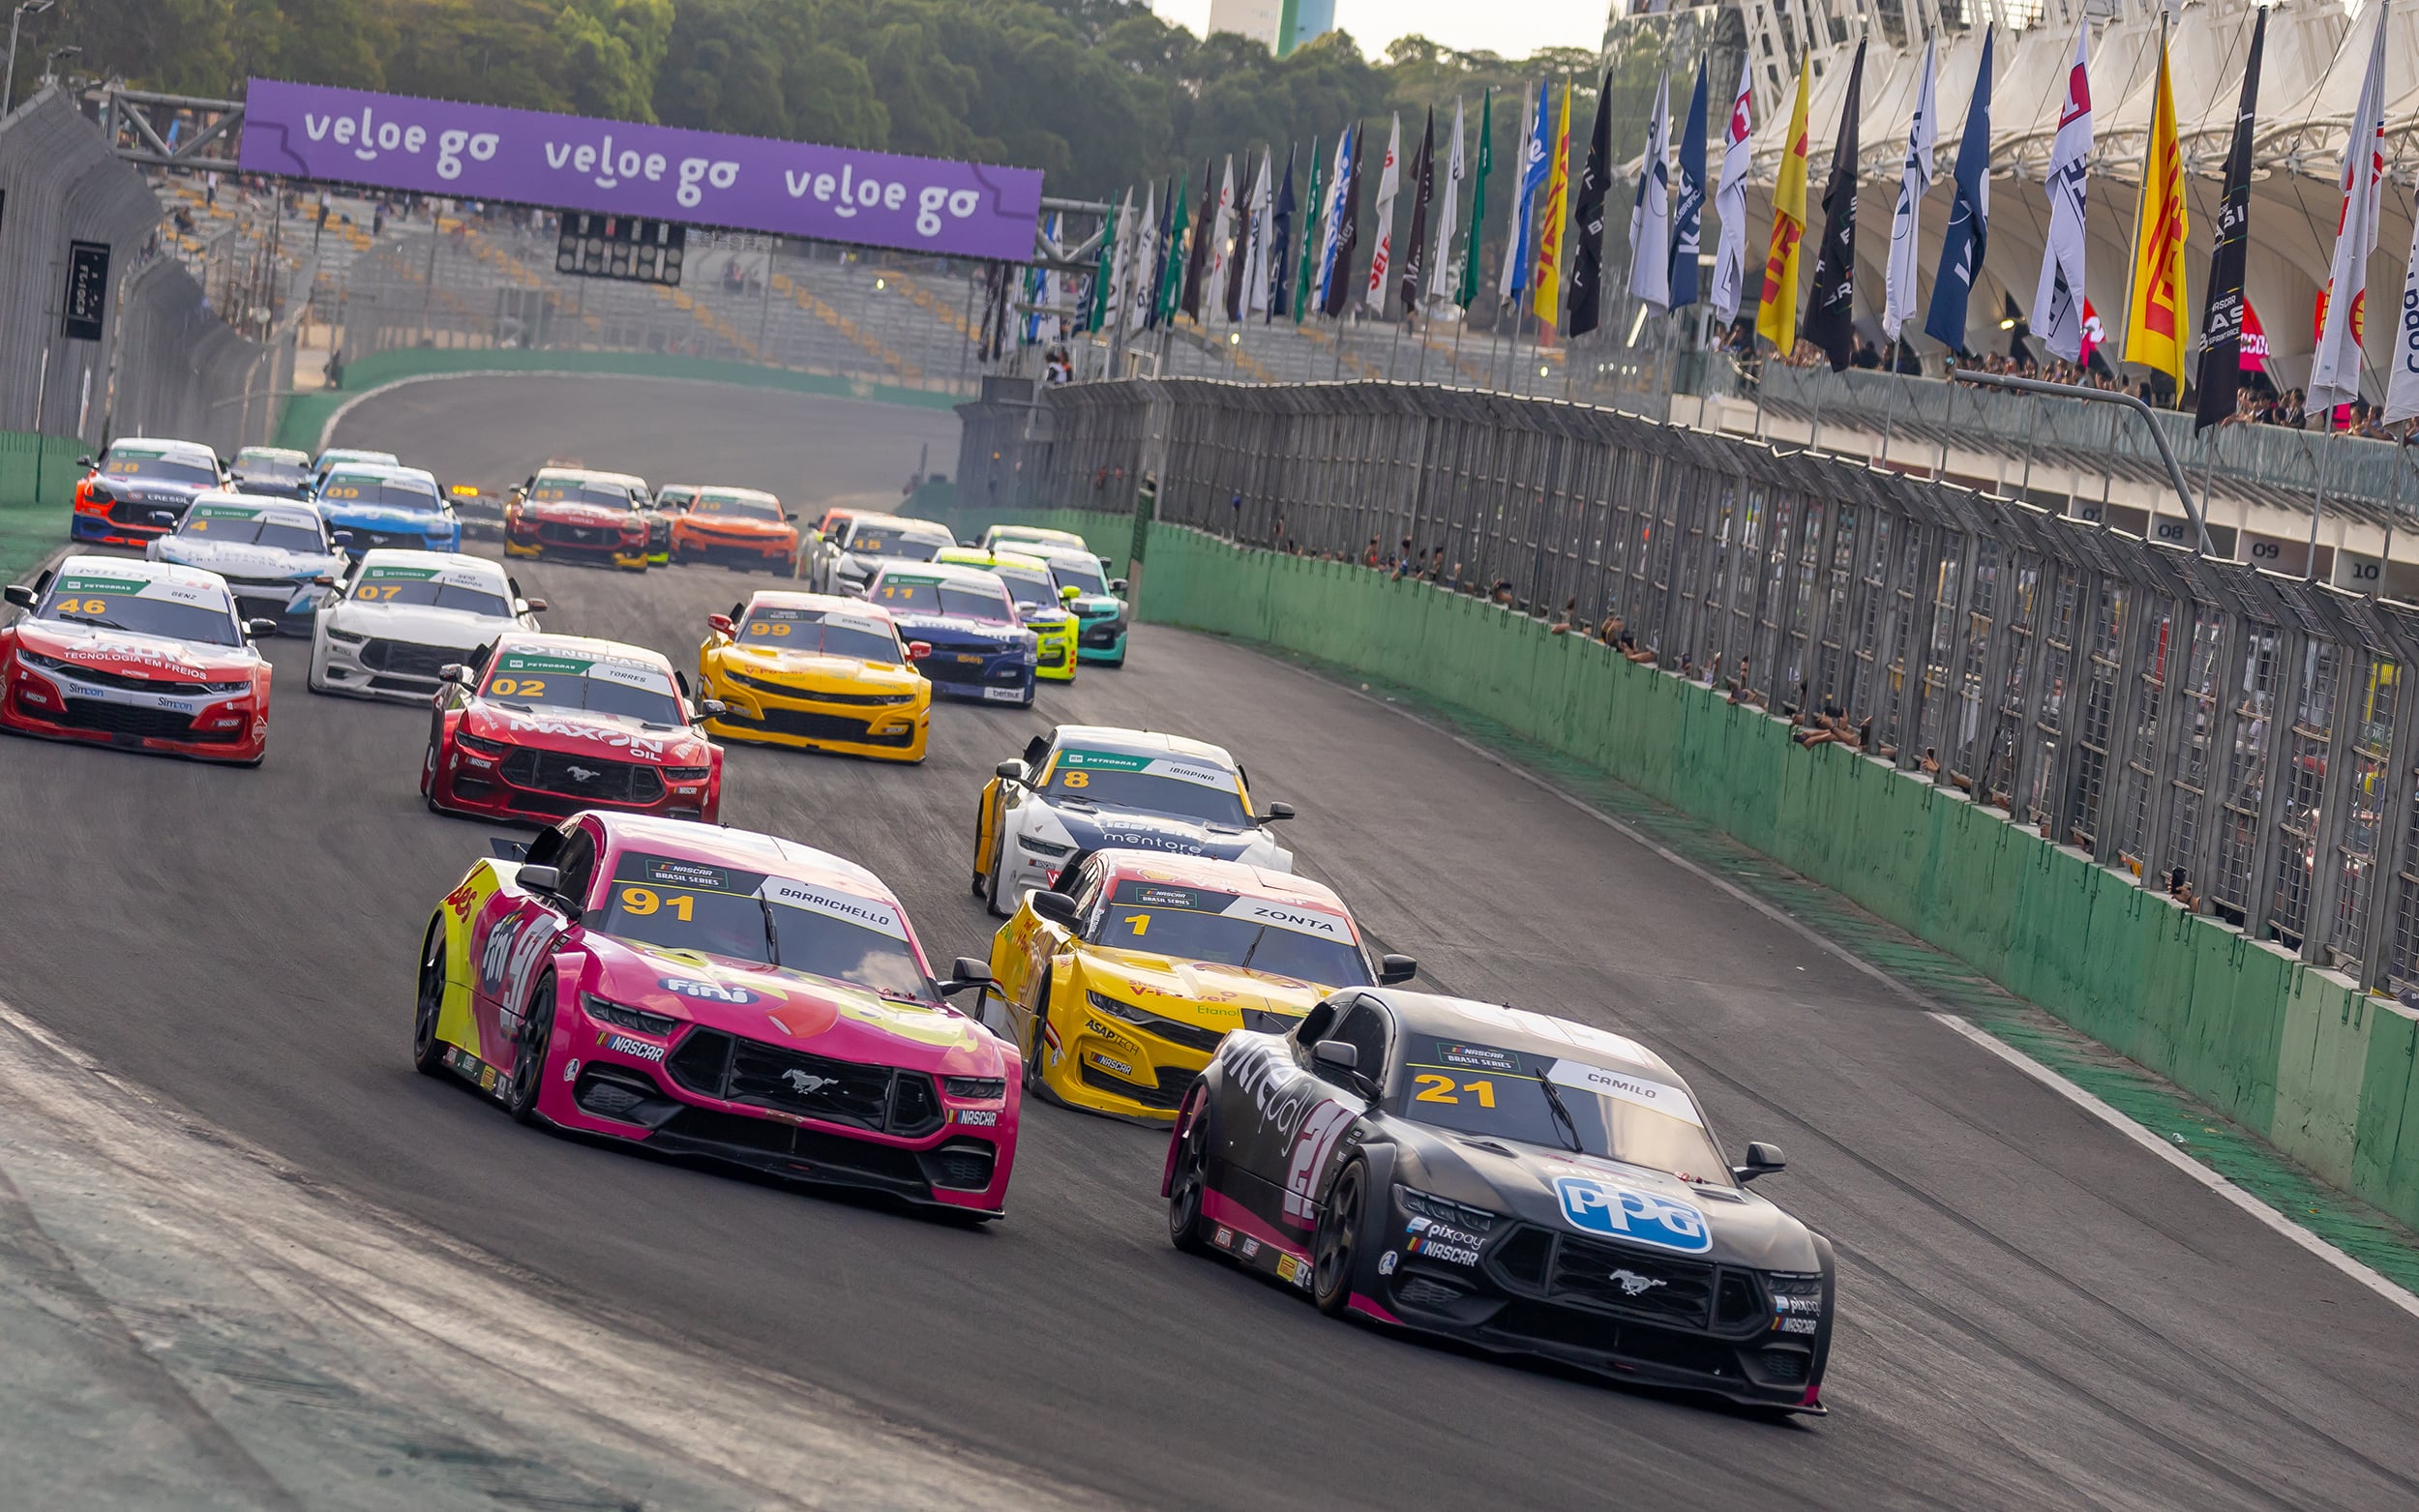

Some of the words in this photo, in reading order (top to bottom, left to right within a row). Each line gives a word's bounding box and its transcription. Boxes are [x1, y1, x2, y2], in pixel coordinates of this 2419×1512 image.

[304, 106, 427, 161] veloe
[436, 130, 500, 180] go
[545, 135, 667, 189] veloe
[676, 157, 740, 208] go
[785, 164, 908, 218] veloe
[916, 187, 980, 237] go
[190, 519, 209, 531] 4
[2158, 523, 2184, 541] 08
[2252, 542, 2279, 558] 09
[2352, 563, 2379, 579] 10
[84, 582, 132, 591] PETROBRAS
[357, 585, 403, 601] 07
[881, 586, 914, 600] 11
[56, 598, 107, 615] 46
[750, 622, 791, 637] 99
[64, 651, 142, 664] TECNOLOGIA
[144, 657, 162, 668] EM
[164, 663, 208, 681] FREIOS
[526, 662, 577, 670] PETROBRAS
[609, 670, 647, 683] TORRES
[69, 682, 105, 697] Simcon
[491, 678, 546, 697] 02
[158, 697, 193, 711] Simcon
[510, 719, 664, 755] MAXON
[629, 749, 662, 762] OIL
[1087, 757, 1138, 767] PETROBRAS
[1063, 771, 1090, 788] 8
[1169, 766, 1215, 783] IBIAPINA
[655, 872, 688, 882] BRASIL
[689, 875, 720, 886] SERIES
[672, 865, 713, 876] NASCAR
[1142, 896, 1166, 904] BRASIL
[1166, 898, 1190, 906] SERIES
[1154, 889, 1186, 899] NASCAR
[621, 887, 695, 922] 91
[779, 887, 890, 926] BARRICHELLO
[1123, 914, 1151, 936] 1
[1253, 906, 1334, 933] ZONTA
[668, 978, 749, 1004] Fini
[1197, 1006, 1239, 1017] Etanol
[611, 1035, 666, 1063] NASCAR
[1463, 1048, 1505, 1059] NASCAR
[1099, 1055, 1132, 1075] NASCAR
[1448, 1055, 1479, 1066] BRASIL
[1480, 1059, 1512, 1069] SERIES
[1414, 1074, 1496, 1109] 21
[1587, 1073, 1657, 1099] CAMILO
[960, 1110, 997, 1127] NASCAR
[1565, 1179, 1702, 1239] PPG
[1427, 1222, 1487, 1251] pixpay
[1422, 1242, 1479, 1267] NASCAR
[1781, 1317, 1816, 1335] NASCAR
